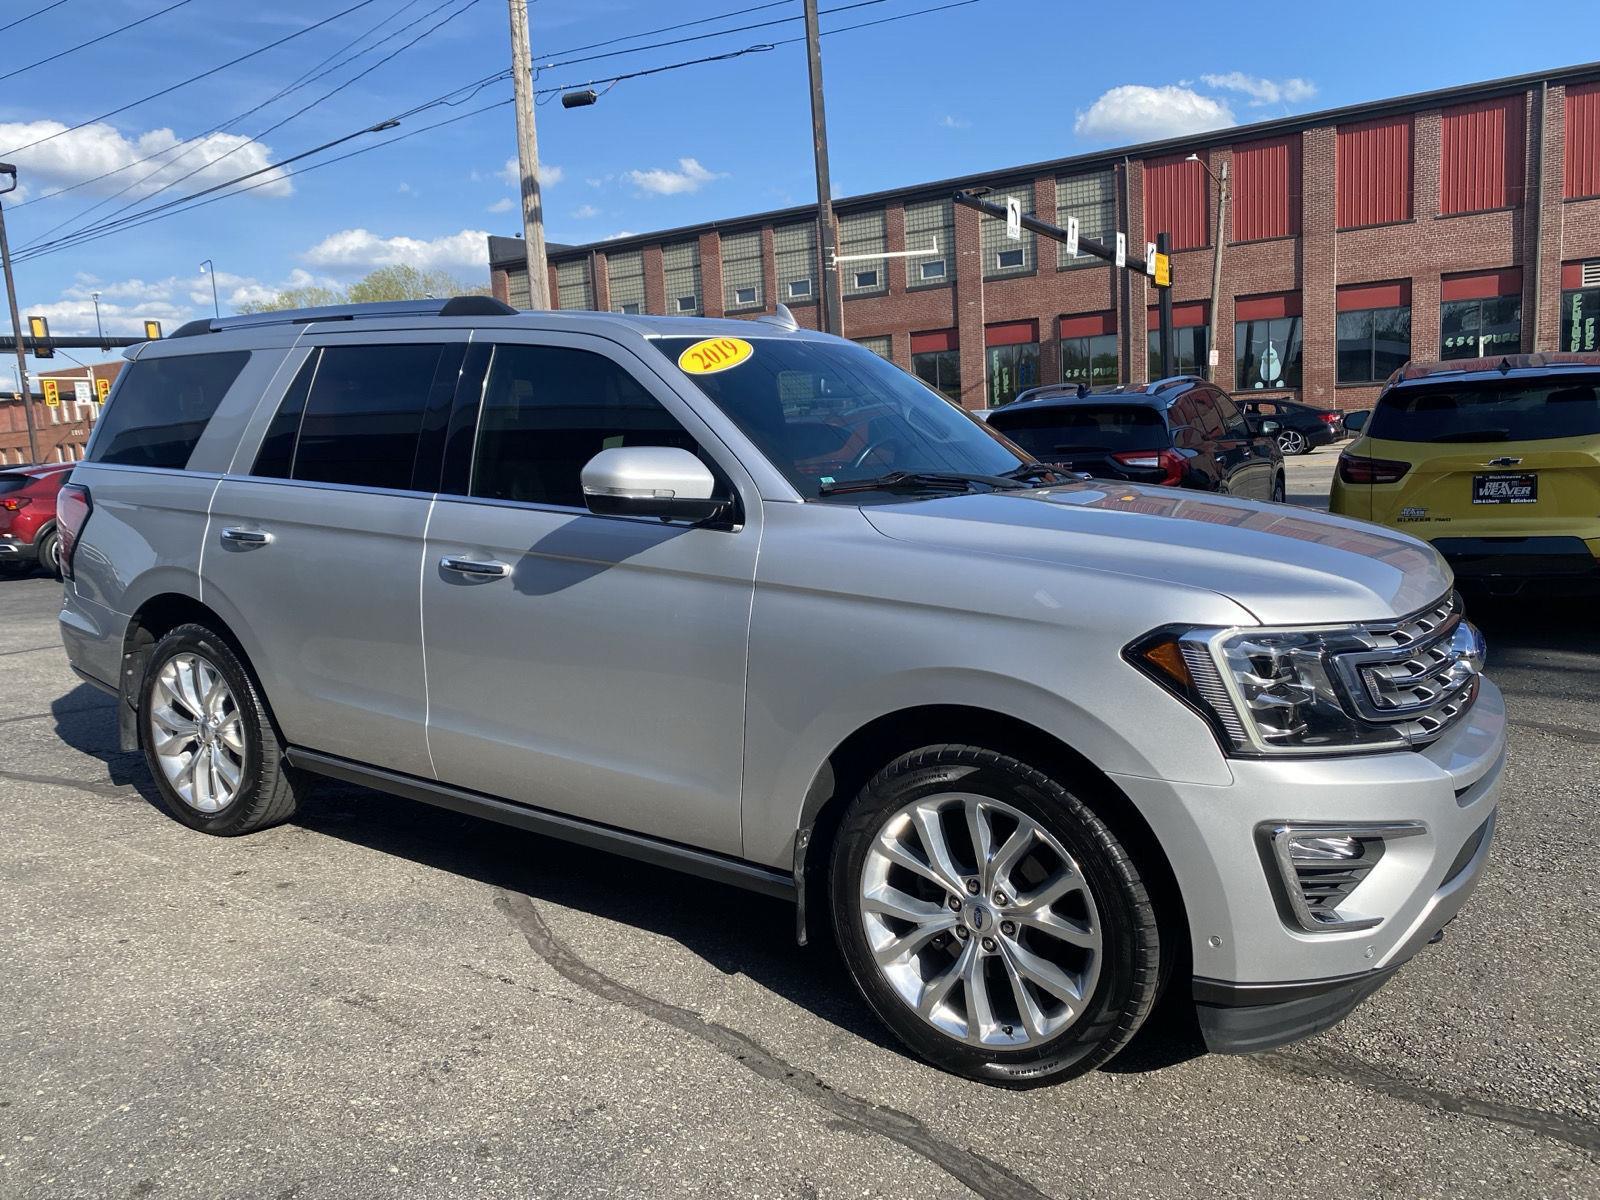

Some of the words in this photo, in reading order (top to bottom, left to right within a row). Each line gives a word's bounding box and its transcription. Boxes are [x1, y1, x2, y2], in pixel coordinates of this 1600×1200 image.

[691, 340, 738, 370] 2019
[1485, 481, 1510, 489] RICK
[1479, 486, 1531, 496] WEAVER
